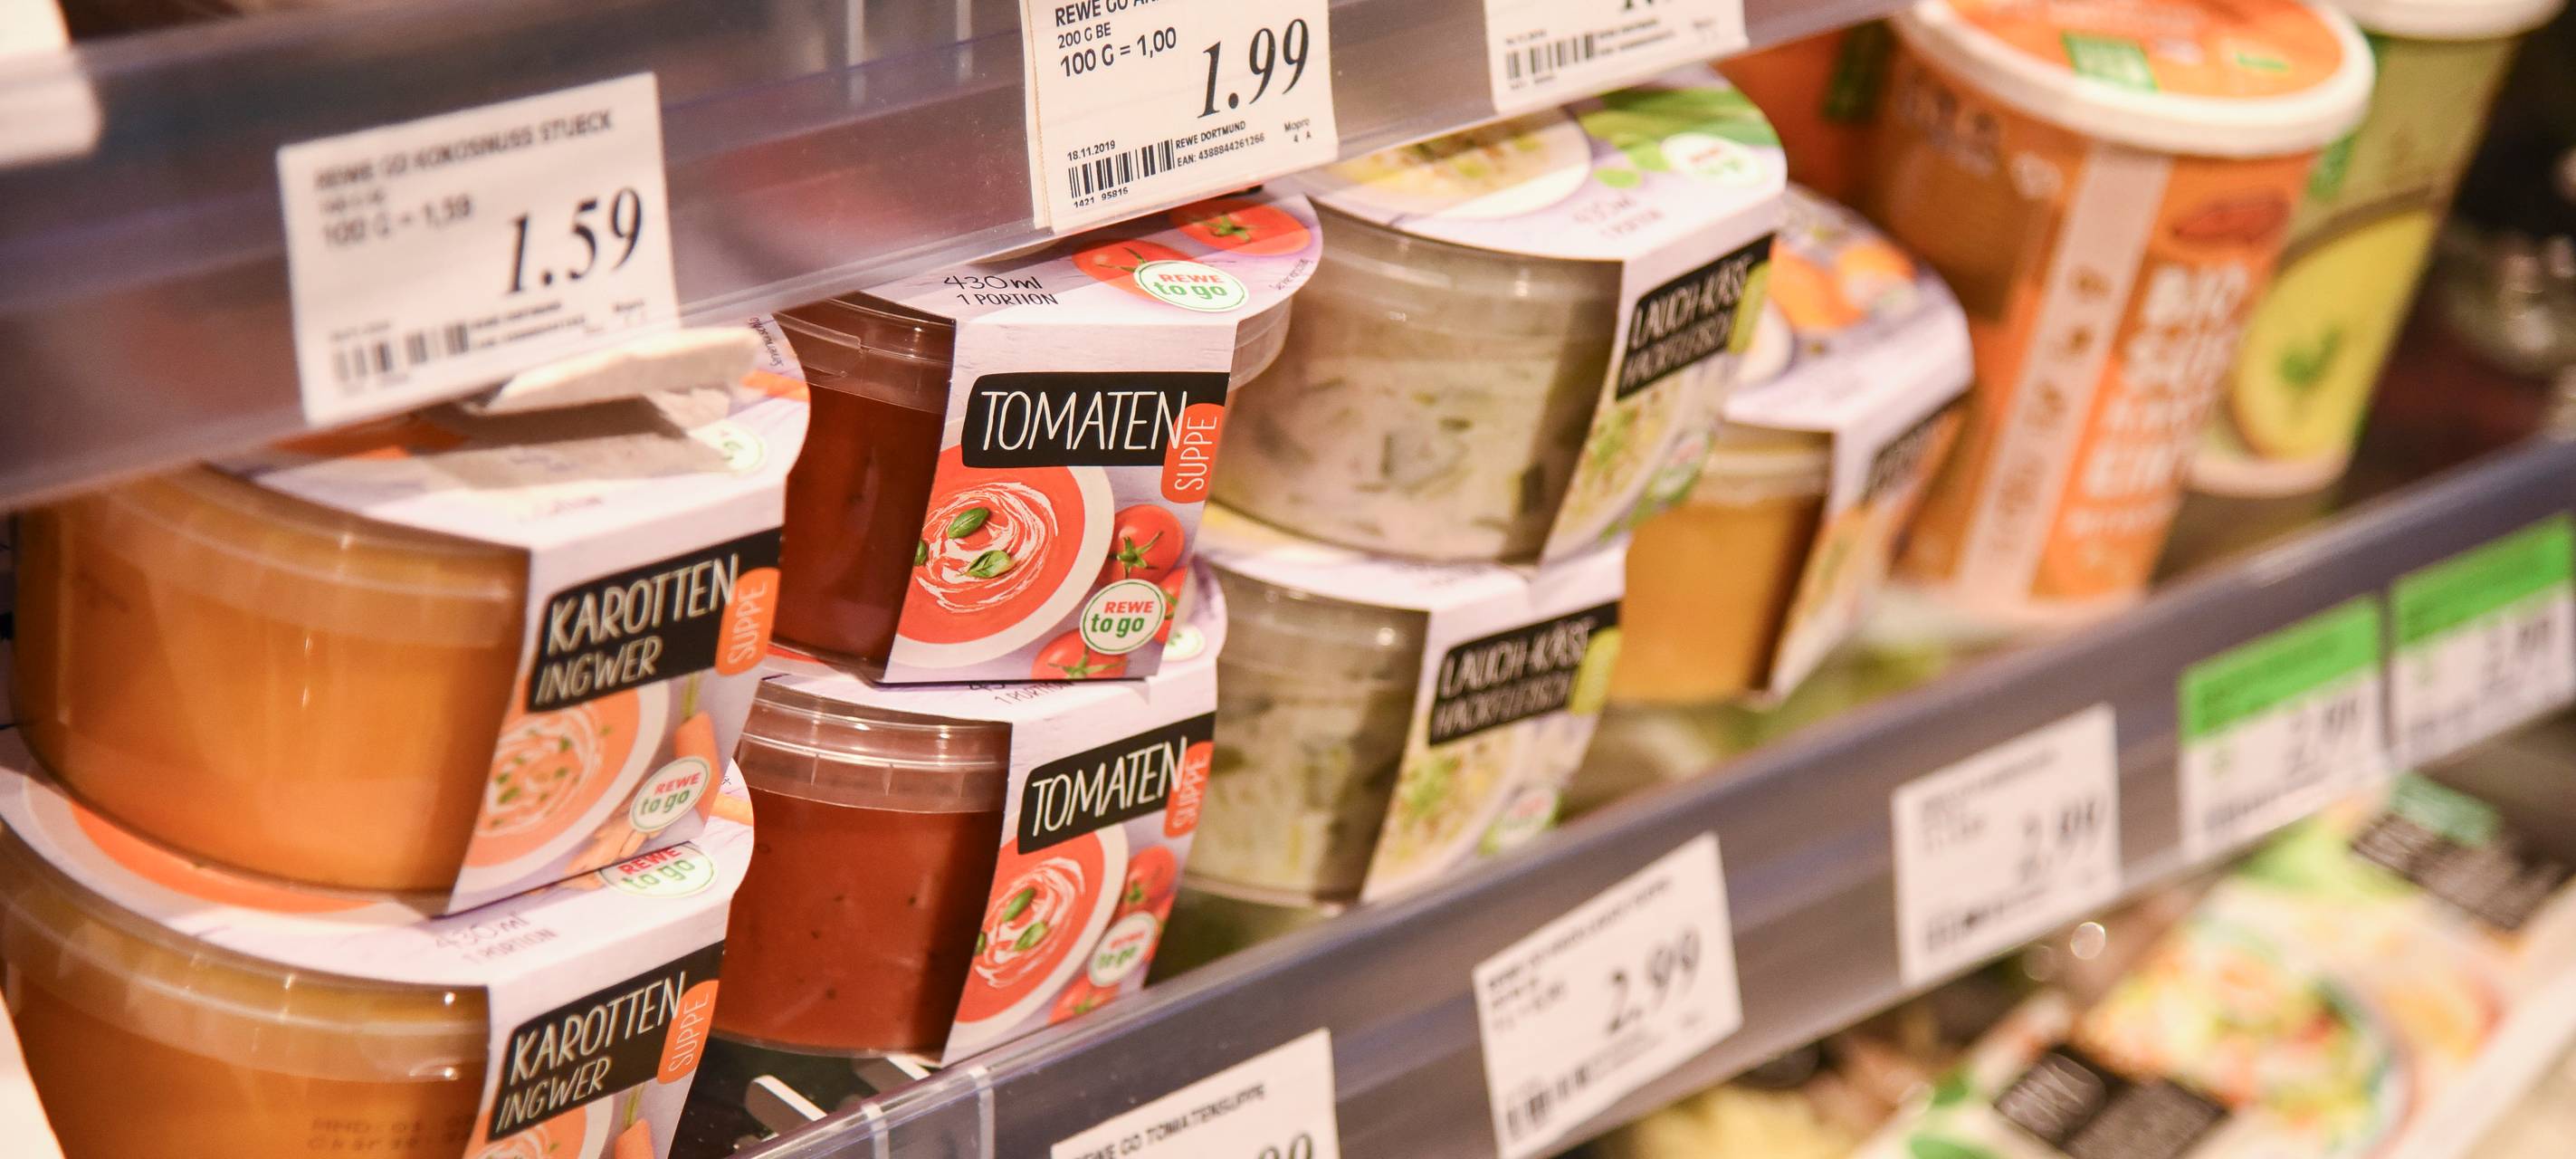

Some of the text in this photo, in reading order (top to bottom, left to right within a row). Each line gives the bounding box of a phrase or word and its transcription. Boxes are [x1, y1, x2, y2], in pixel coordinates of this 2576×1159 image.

[1055, 0, 1102, 27] REWE
[1058, 22, 1111, 50] 200 G BE
[1060, 48, 1096, 77] 100
[1102, 43, 1114, 66] G
[1137, 26, 1177, 58] 1,00
[1197, 18, 1310, 119] 1.99
[539, 110, 612, 142] STUECK
[1176, 120, 1246, 149] REWE DORTMUND
[1067, 139, 1116, 162] 18.11.2019
[1177, 153, 1197, 167] EAN:
[1073, 196, 1095, 208] 1421
[506, 187, 644, 295] 1.59
[1154, 280, 1227, 301] to go
[1158, 272, 1225, 284] REWE
[957, 292, 1059, 306] 1 PORTION
[980, 390, 1188, 452] TOMATEN
[1174, 416, 1217, 492] SUPPE
[547, 553, 739, 656] KAROTTEN
[1103, 600, 1155, 616] REWE
[728, 581, 768, 665] SUPPE
[1091, 613, 1146, 638] to go
[534, 635, 663, 706] INGWER
[654, 771, 701, 794] REWE
[1031, 735, 1188, 838] TOMATEN
[1171, 753, 1209, 829] SUPPE
[640, 790, 690, 815] to go
[618, 848, 682, 876] REWE
[664, 859, 696, 882] go
[509, 971, 686, 1086] KAROTTEN
[668, 993, 710, 1073] SUPPE
[495, 1056, 612, 1134] INGWER
